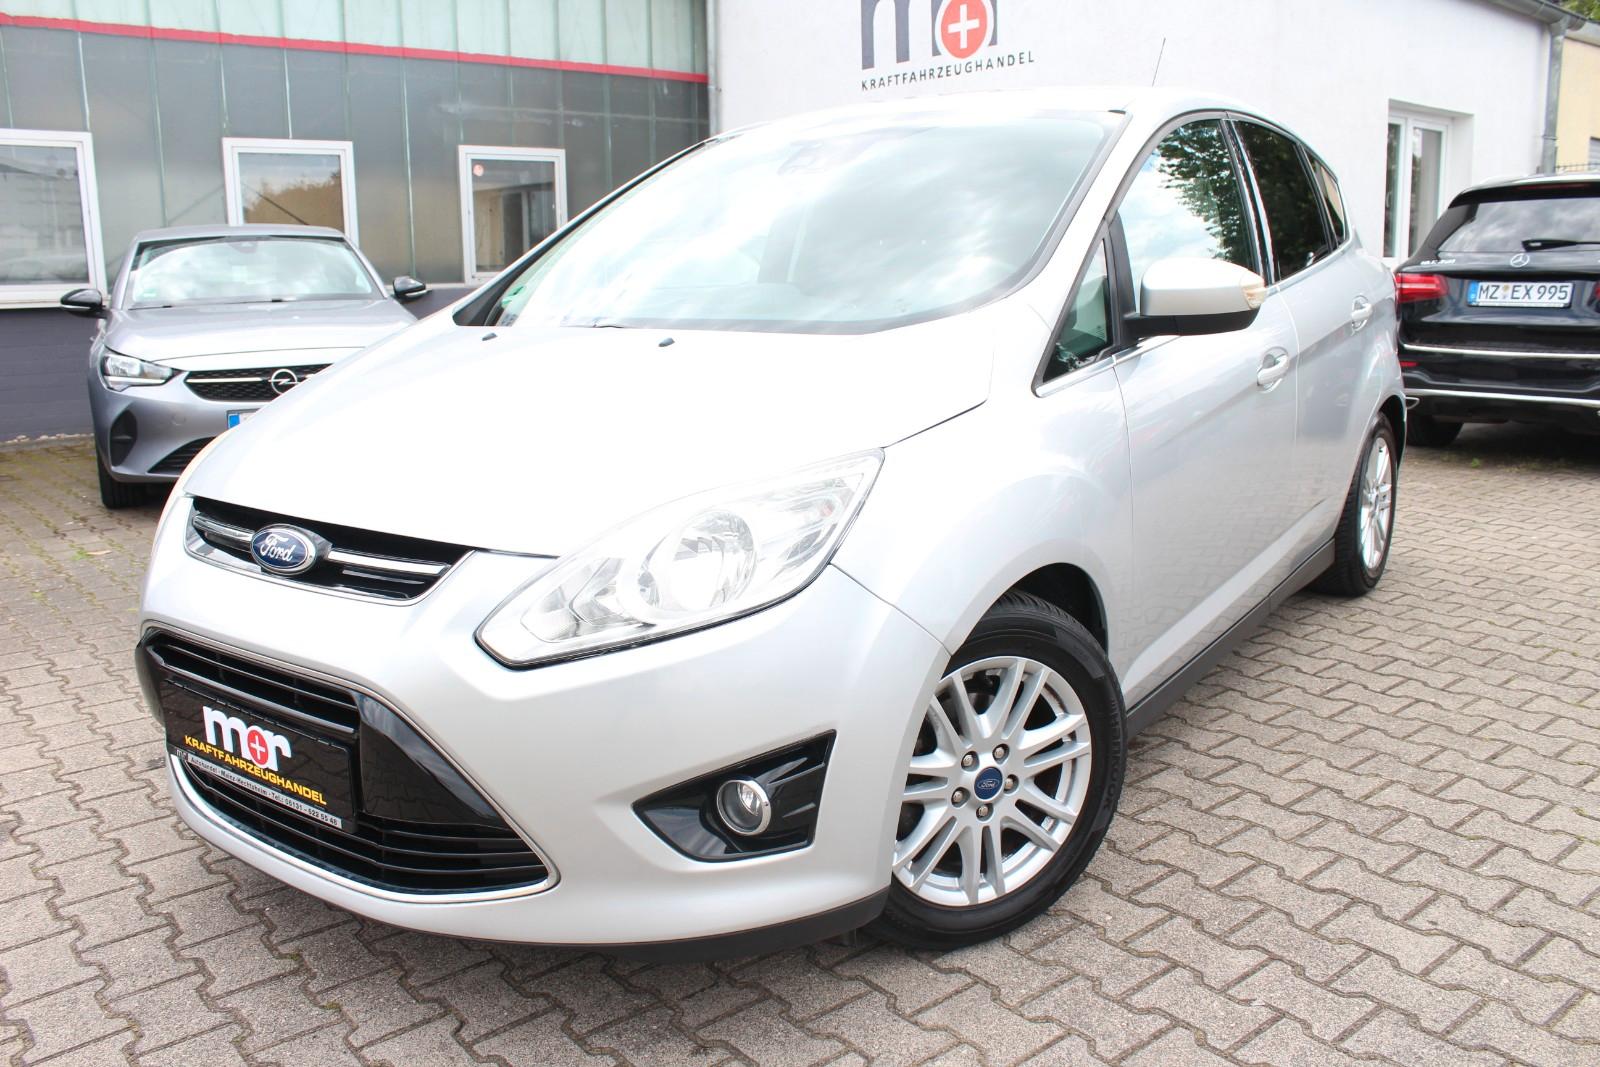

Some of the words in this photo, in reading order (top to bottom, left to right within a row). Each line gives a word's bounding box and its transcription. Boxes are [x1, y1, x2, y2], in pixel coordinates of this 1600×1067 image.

[861, 51, 1035, 91] KRAFTFAHRZEUGHANDEL
[1479, 285, 1500, 300] MZ
[1511, 286, 1532, 300] EX
[1537, 286, 1570, 300] 995
[260, 533, 297, 561] Ford
[184, 735, 327, 805] KRAFTFAHRZEUGHANDEL
